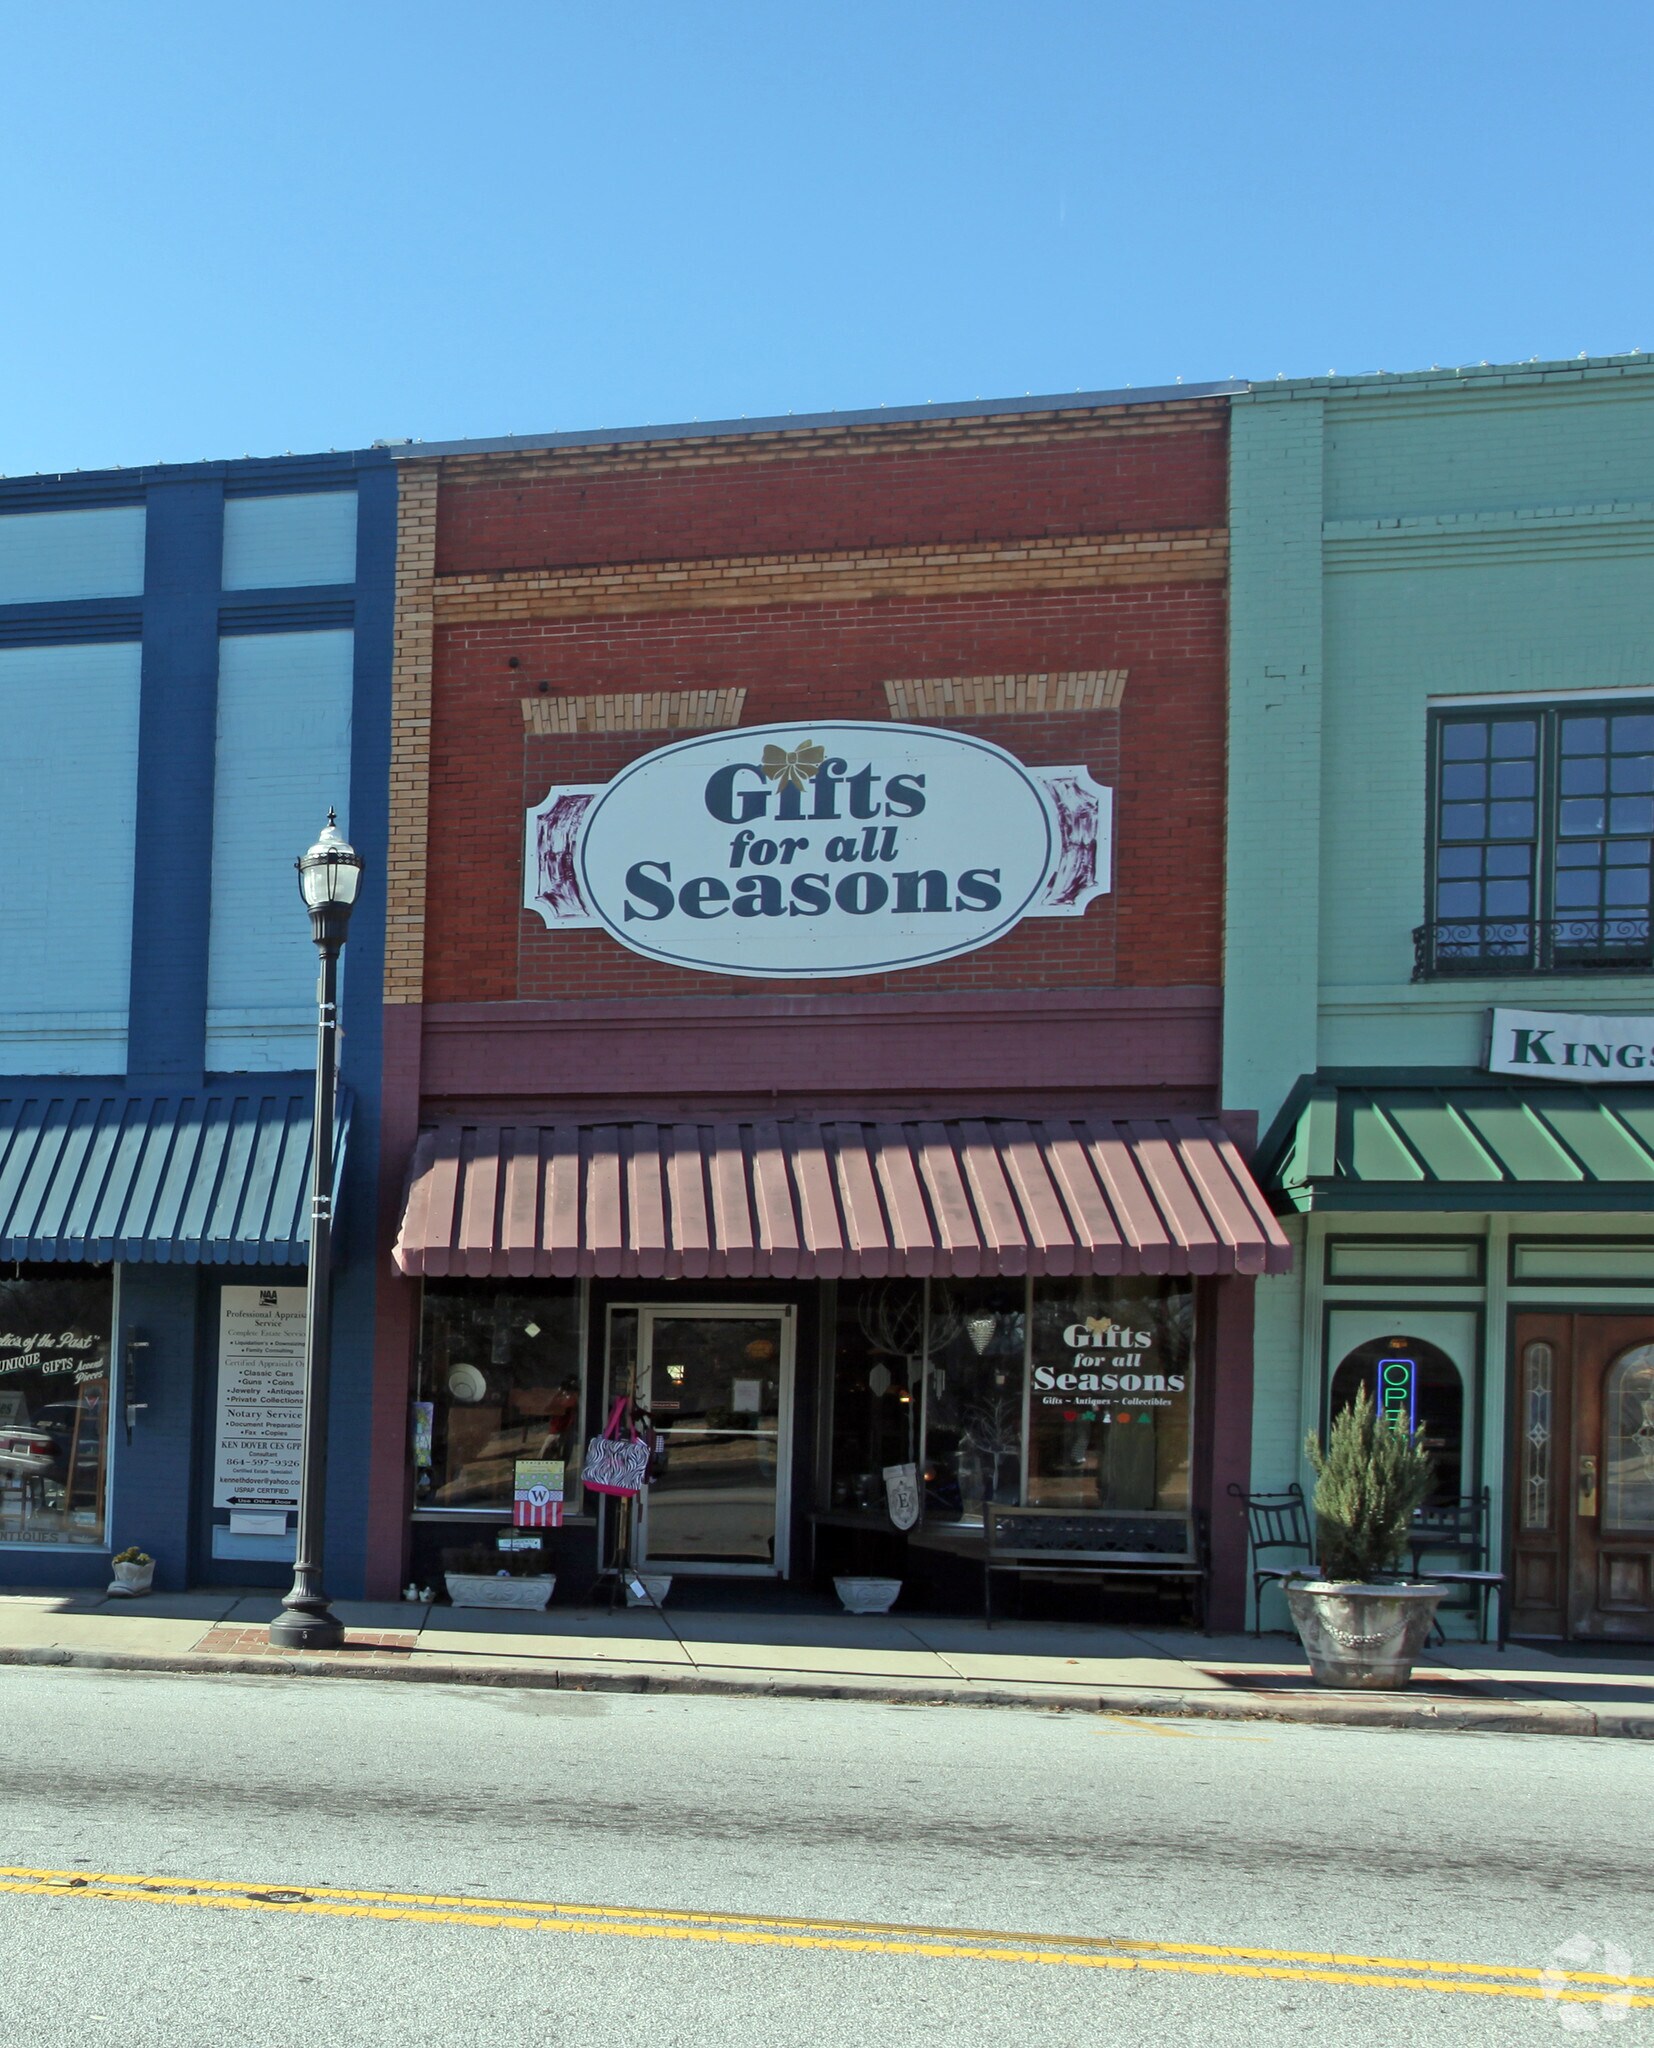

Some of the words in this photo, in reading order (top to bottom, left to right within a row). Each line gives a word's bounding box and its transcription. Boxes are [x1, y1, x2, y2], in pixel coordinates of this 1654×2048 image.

[704, 757, 926, 825] Gifts
[729, 829, 809, 868] for
[825, 826, 899, 862] all
[624, 861, 1002, 922] Seasons
[260, 1290, 278, 1299] NAA
[226, 1310, 272, 1318] Professional
[255, 1319, 282, 1327] Service
[227, 1329, 257, 1337] Complete
[1063, 1324, 1152, 1348] Gifts
[23, 1333, 39, 1354] of
[37, 1333, 56, 1348] the
[0, 1352, 41, 1373] UNIQUE
[42, 1357, 74, 1374] GIFTS
[258, 1360, 294, 1369] Appraisals
[1074, 1353, 1106, 1368] for
[1112, 1353, 1142, 1367] all
[1034, 1366, 1185, 1392] Seasons
[1042, 1396, 1063, 1405] Gifts
[1074, 1397, 1111, 1406] Antiques
[1121, 1397, 1172, 1406] Collectibles
[1383, 1364, 1409, 1443] OPE
[227, 1409, 262, 1421] Notary
[266, 1410, 303, 1418] Service
[221, 1441, 239, 1449] KEN
[269, 1442, 285, 1450] CES
[220, 1477, 300, 1486] kennethdover@yahoo.co
[531, 1490, 548, 1502] W
[898, 1492, 909, 1508] E
[302, 1630, 308, 1640] 5
